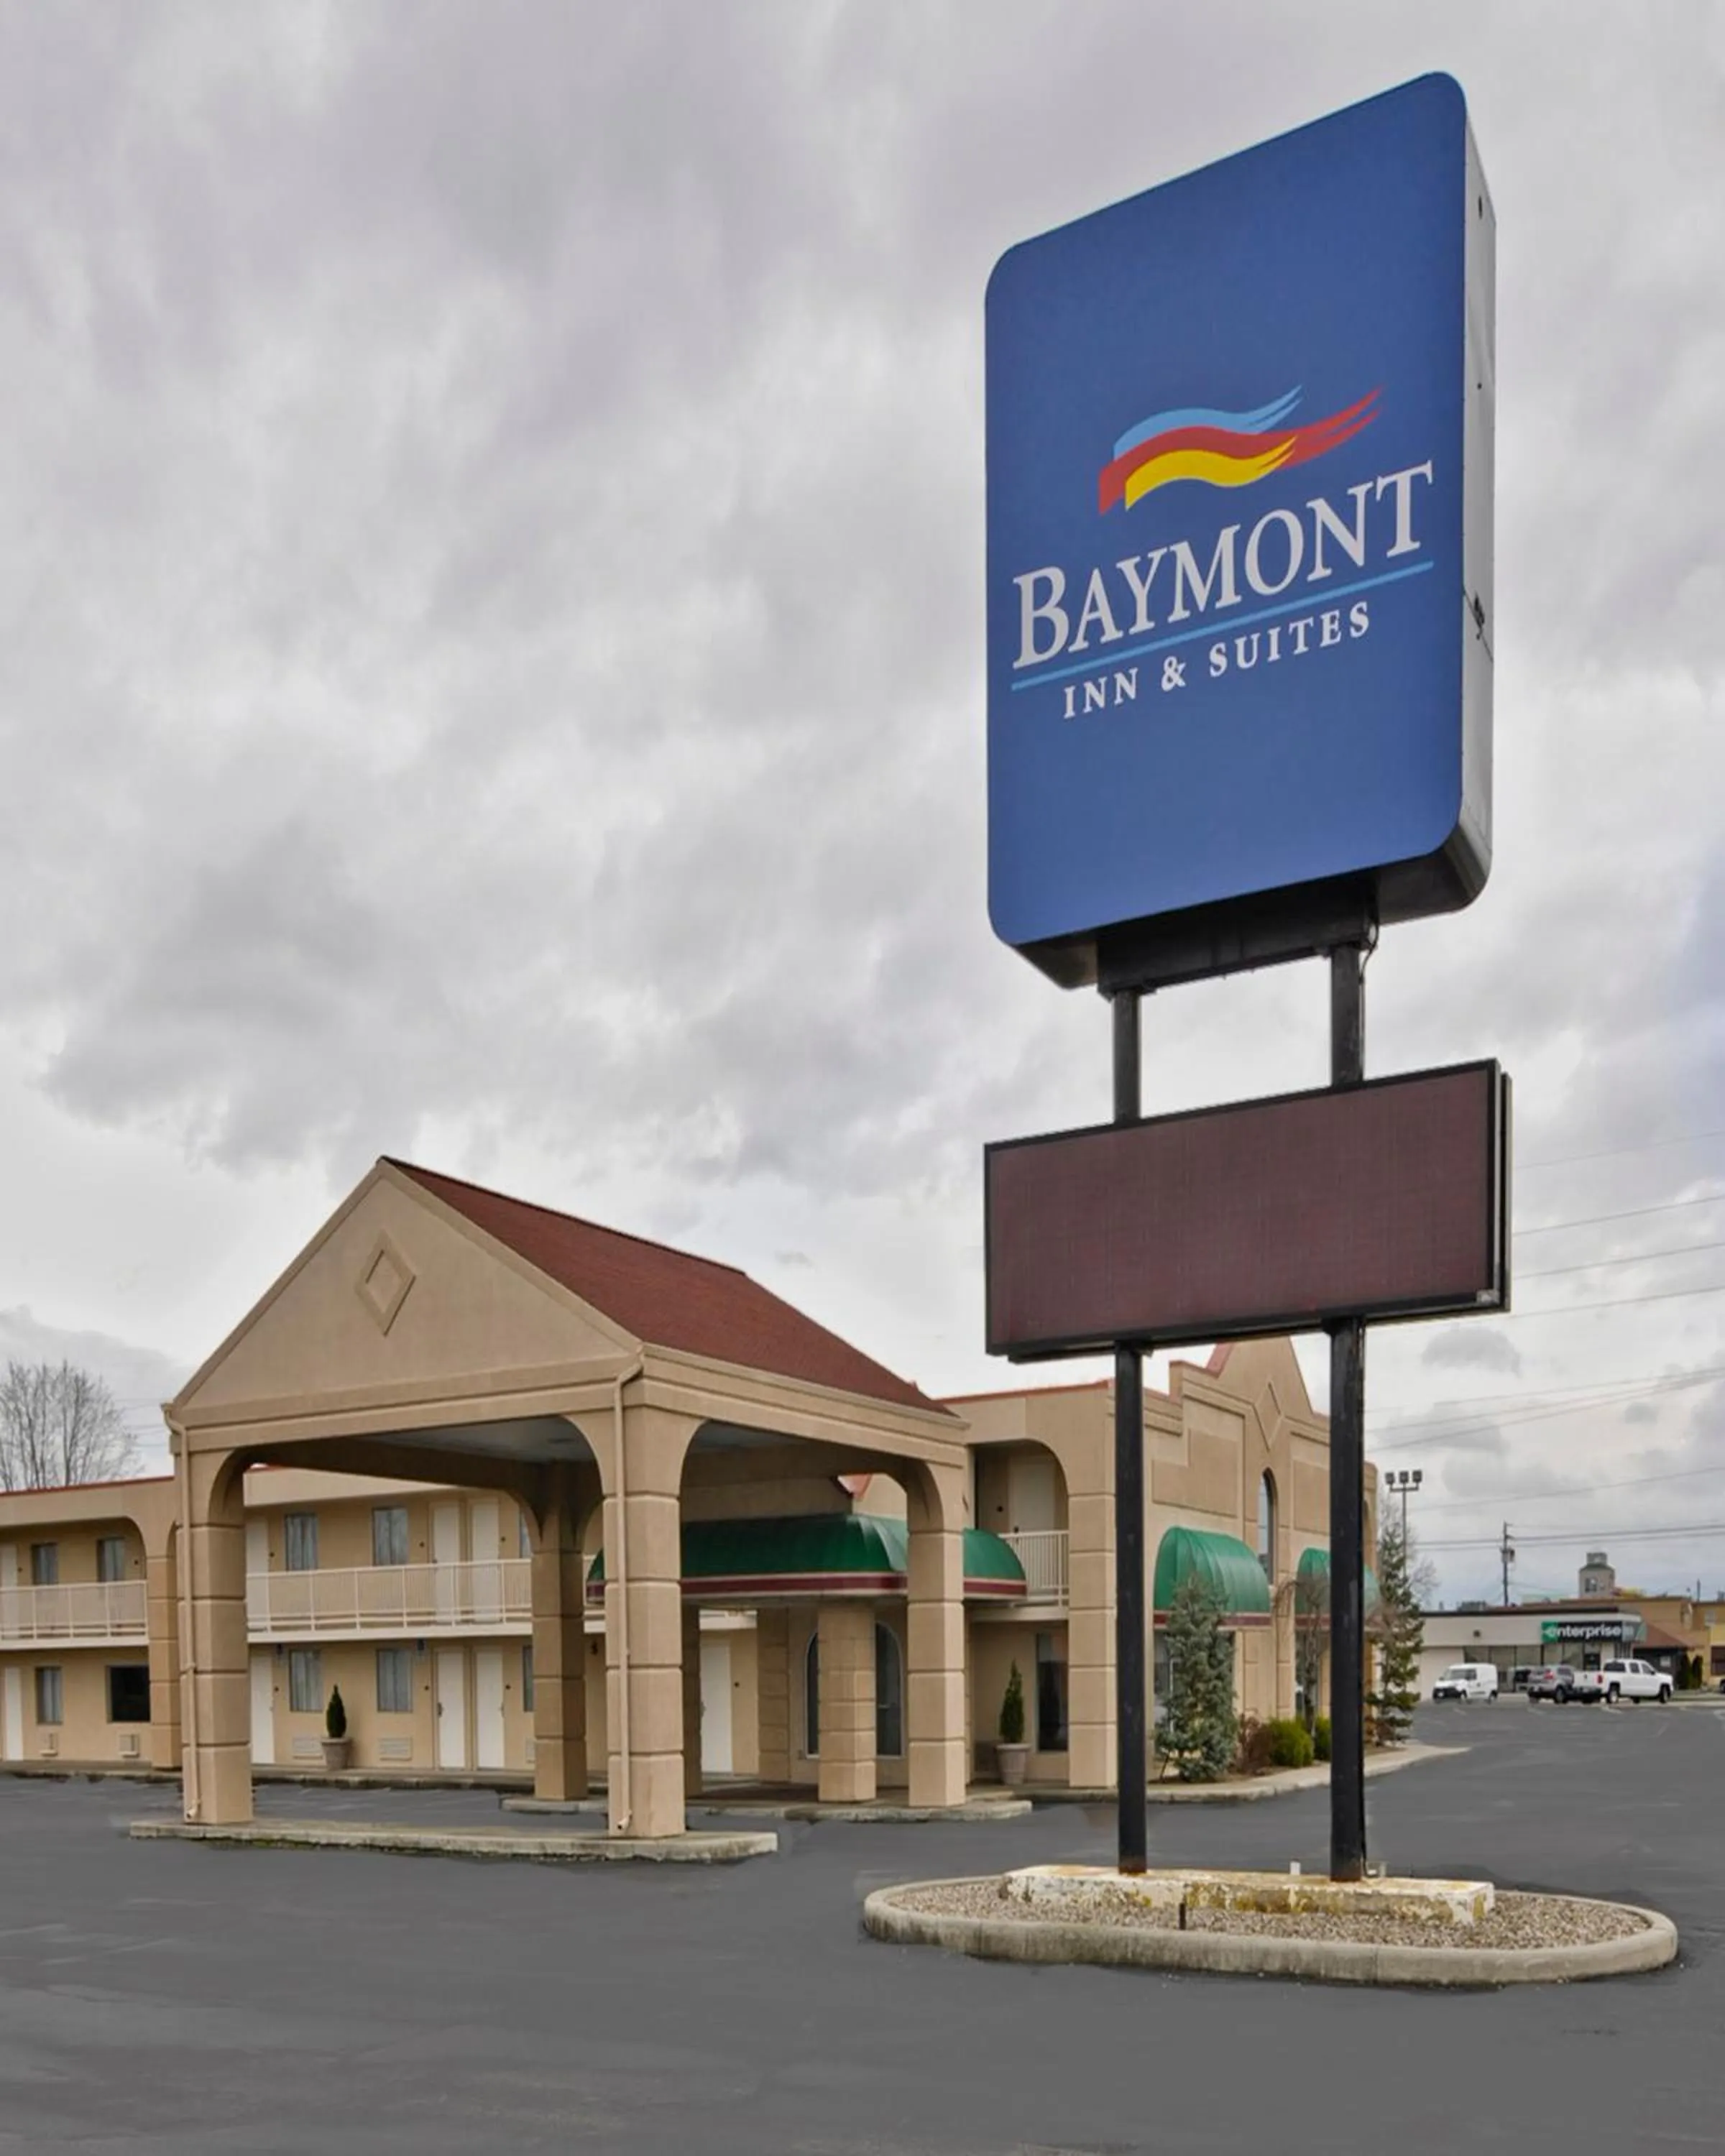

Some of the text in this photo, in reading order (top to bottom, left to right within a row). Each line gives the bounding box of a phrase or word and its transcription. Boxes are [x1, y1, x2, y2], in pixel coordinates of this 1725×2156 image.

[1013, 459, 1434, 670] BAYMONT
[1064, 601, 1370, 719] INN & SUITES
[1544, 1623, 1622, 1639] enterprise
